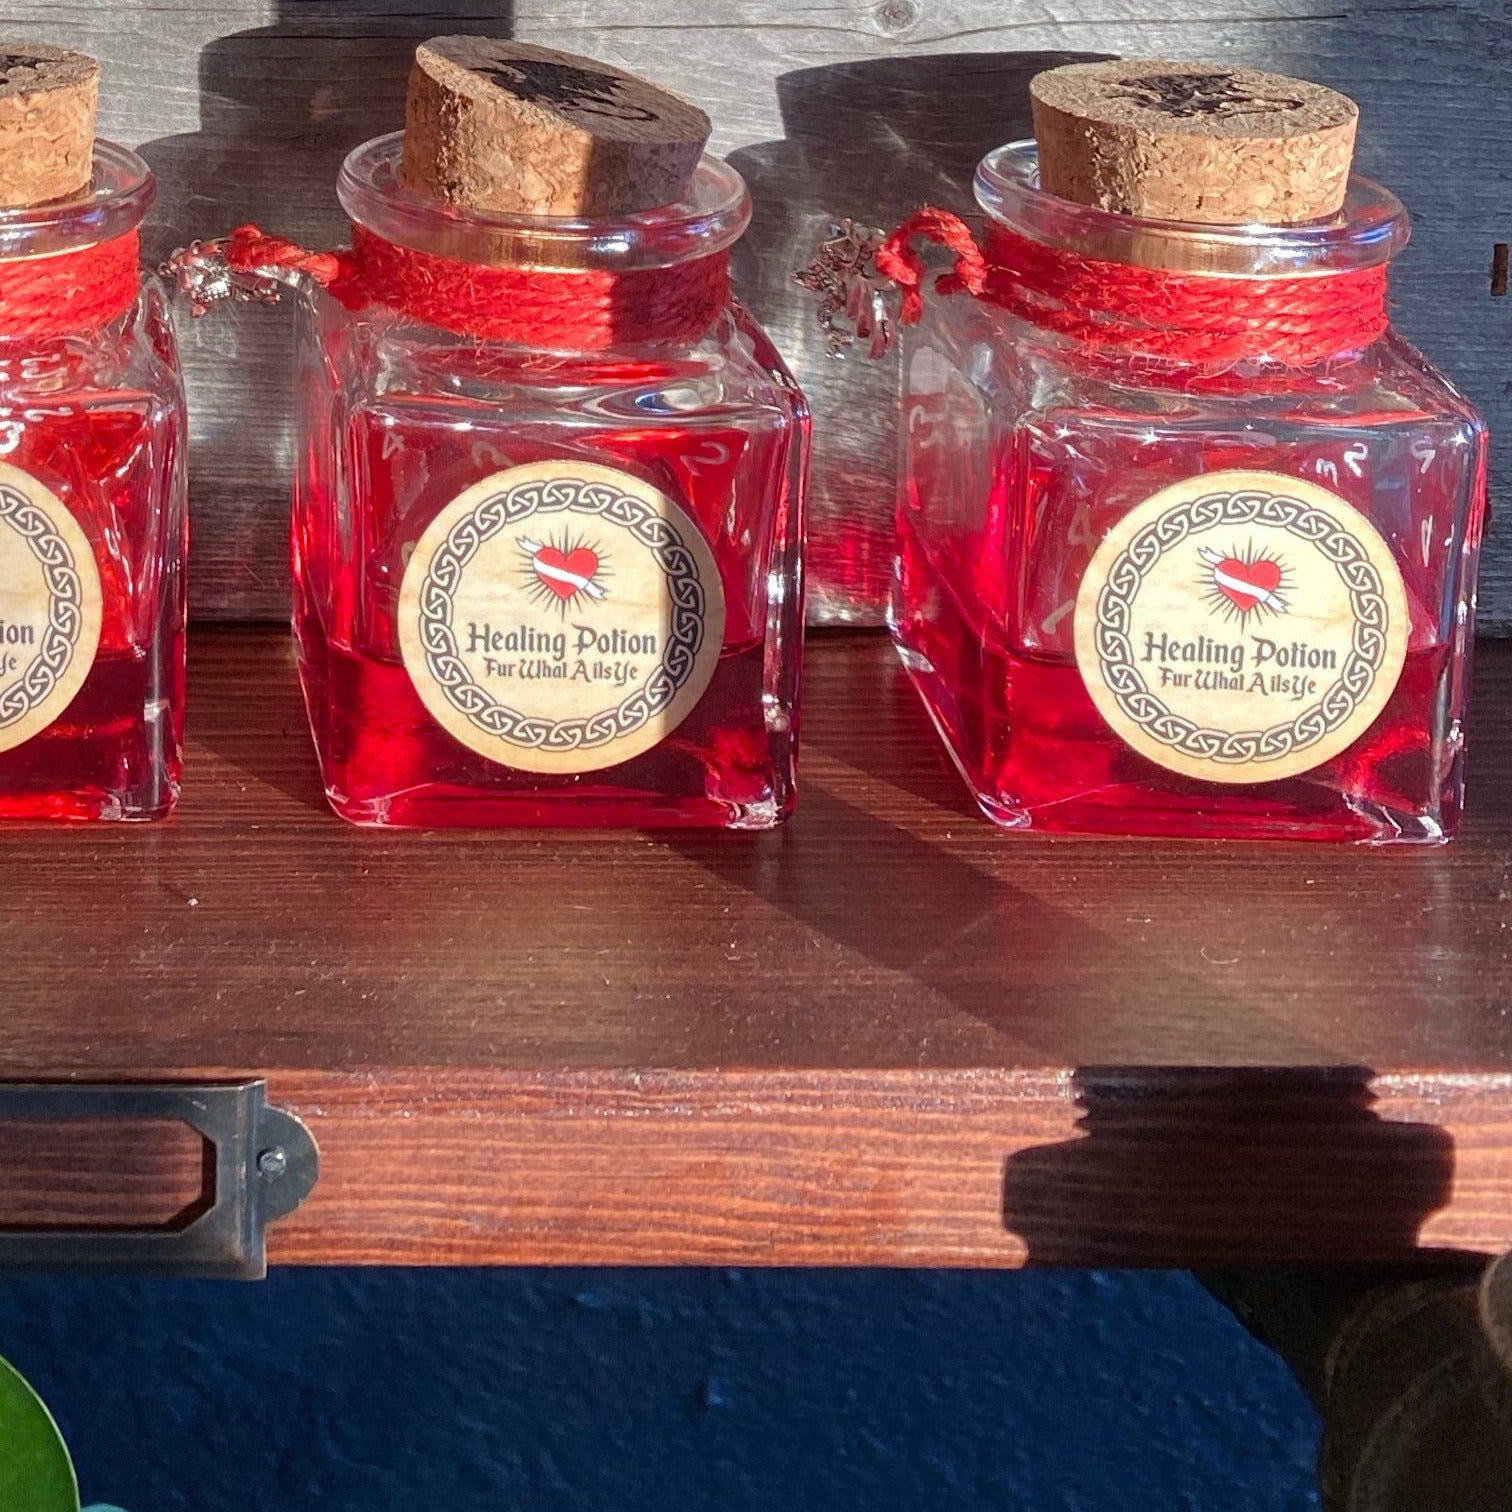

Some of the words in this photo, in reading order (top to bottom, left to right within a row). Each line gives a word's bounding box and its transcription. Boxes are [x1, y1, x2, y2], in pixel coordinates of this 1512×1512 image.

[465, 621, 565, 659] Healing
[572, 623, 657, 654] Potion
[1140, 630, 1244, 670] Healing
[1250, 635, 1337, 670] Potion
[481, 657, 517, 677] Fur
[518, 658, 567, 679] What
[568, 659, 612, 683] Ails
[614, 659, 638, 686] Ye
[1157, 666, 1194, 687] Fur
[1194, 669, 1243, 691] What
[1245, 671, 1290, 697] Ails
[1291, 673, 1317, 701] Ye
